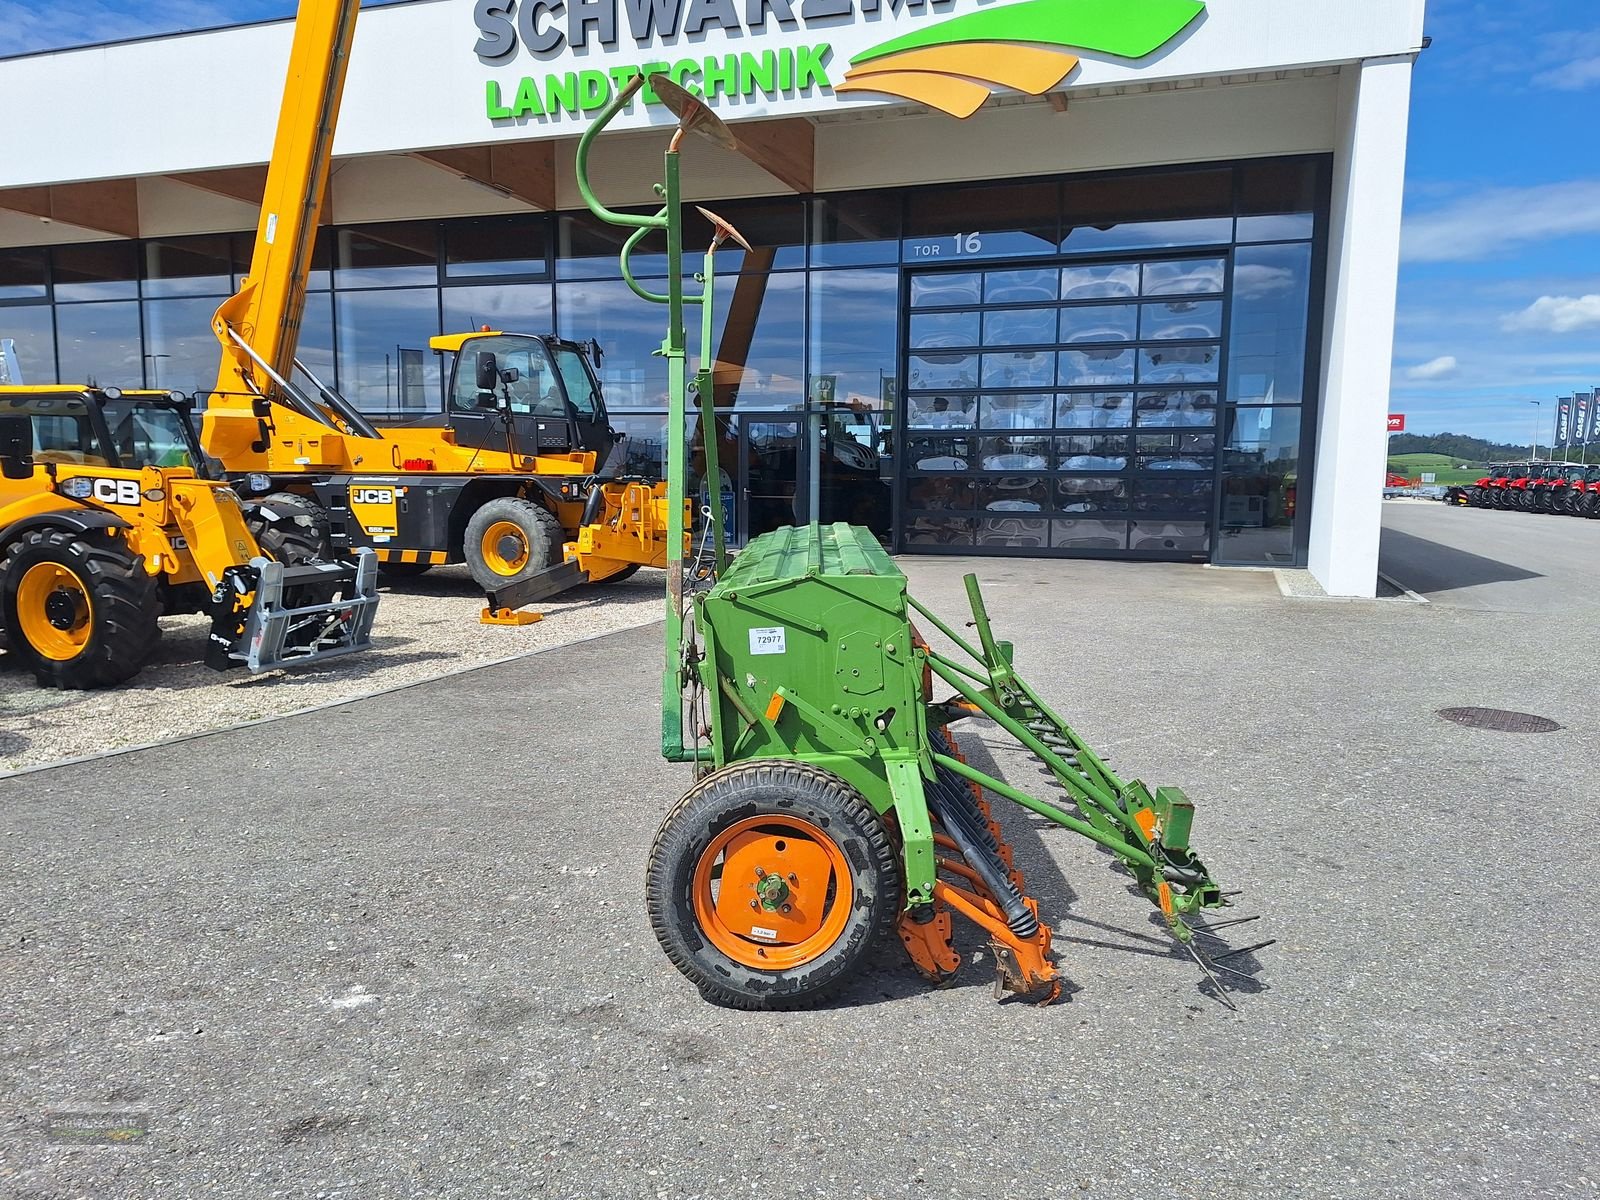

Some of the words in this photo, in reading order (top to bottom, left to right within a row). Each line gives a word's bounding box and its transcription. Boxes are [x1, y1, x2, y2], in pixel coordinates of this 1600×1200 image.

[486, 43, 833, 119] LANDTECHNIK
[914, 245, 940, 256] TOR
[953, 231, 982, 254] 16
[1560, 413, 1568, 440] CASE
[1575, 410, 1586, 438] CASE
[93, 478, 140, 504] CB
[353, 489, 393, 504] JCB
[757, 635, 781, 643] 72977
